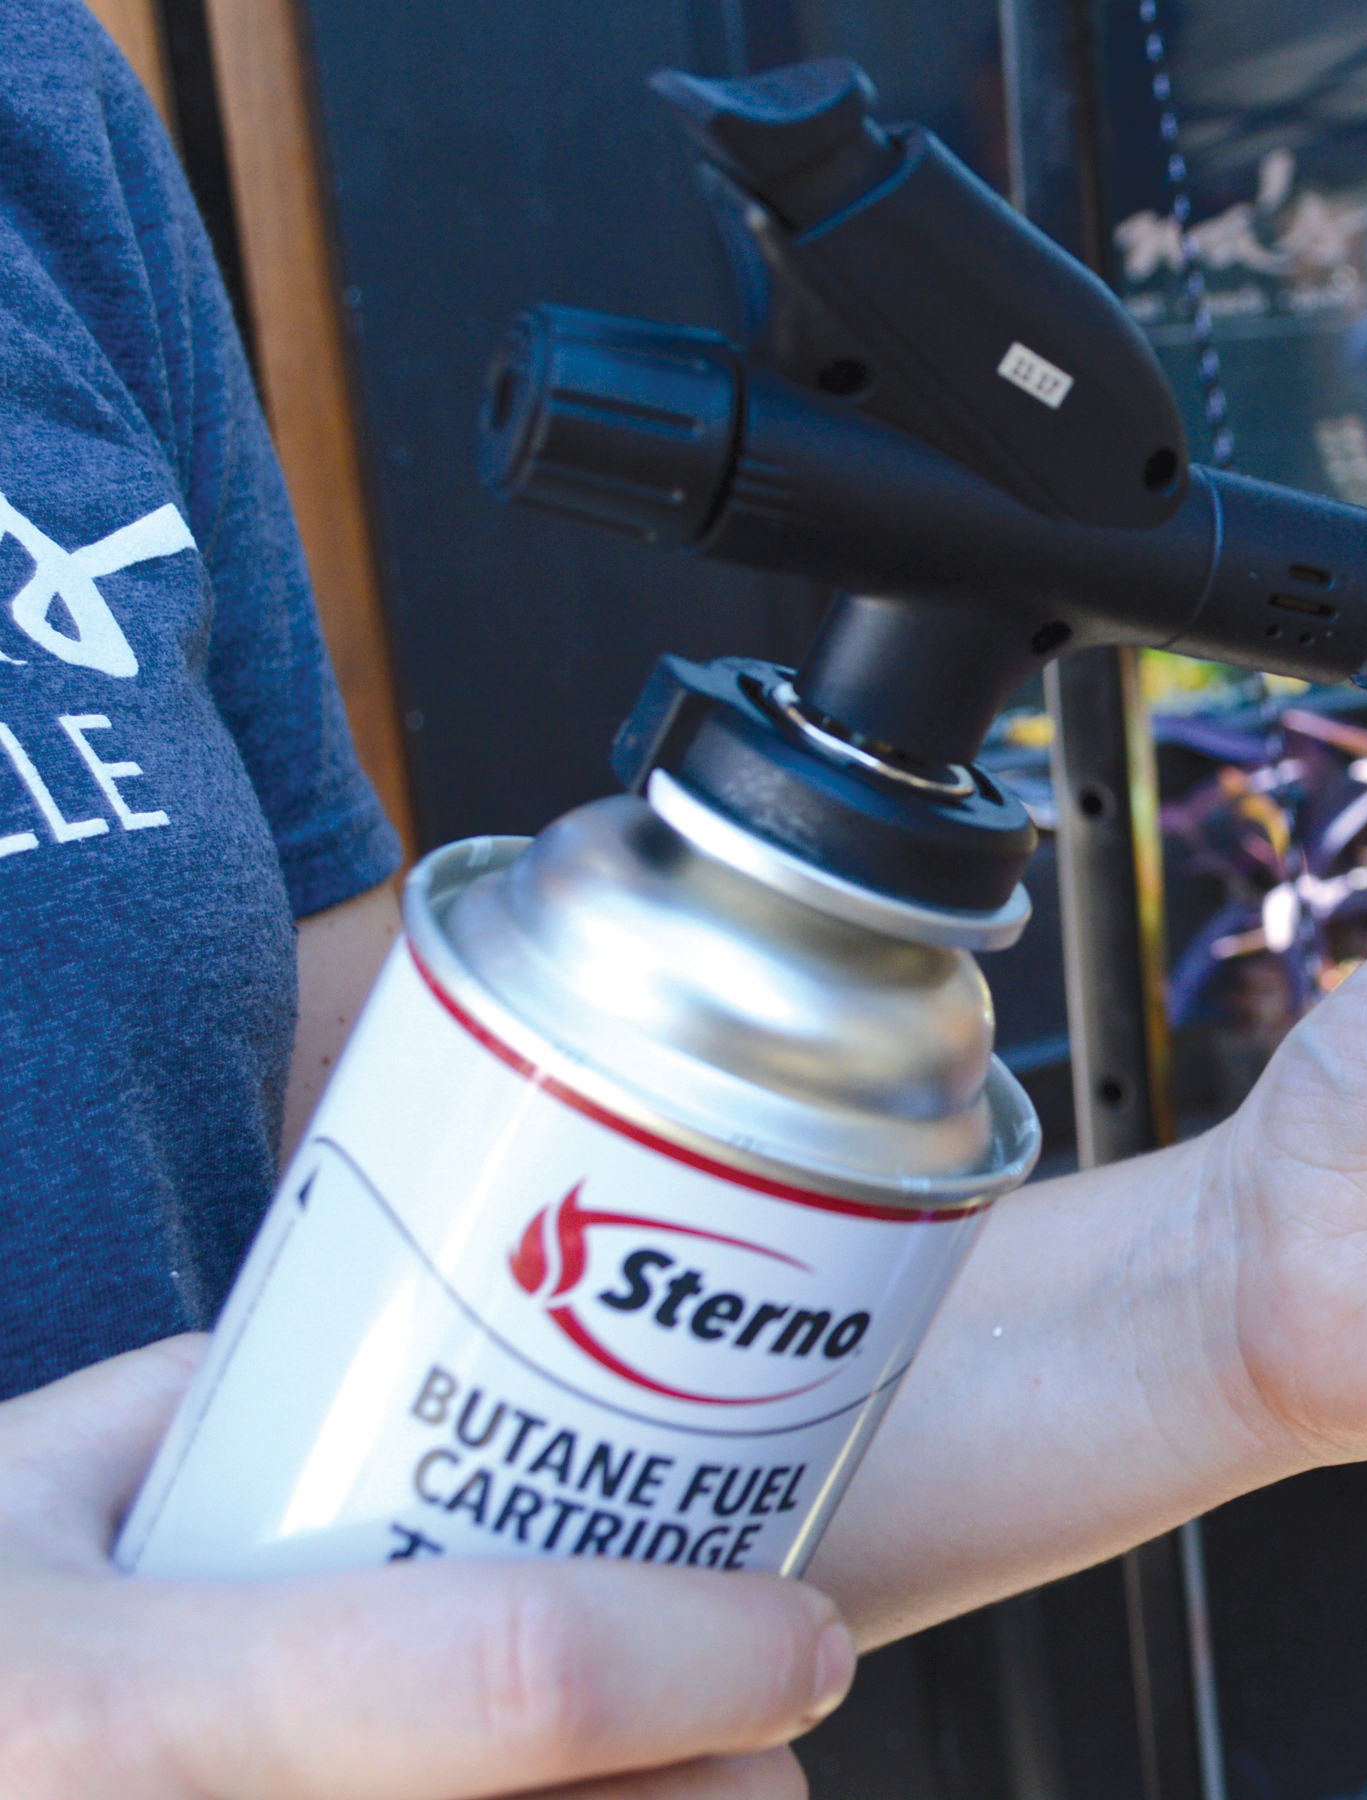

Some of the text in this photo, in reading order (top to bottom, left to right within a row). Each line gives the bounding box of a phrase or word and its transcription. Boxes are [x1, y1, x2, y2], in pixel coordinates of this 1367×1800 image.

[598, 1249, 871, 1359] Sterno
[410, 1365, 807, 1517] BUTANE FUEL
[413, 1448, 763, 1571] CARTRIDGE
